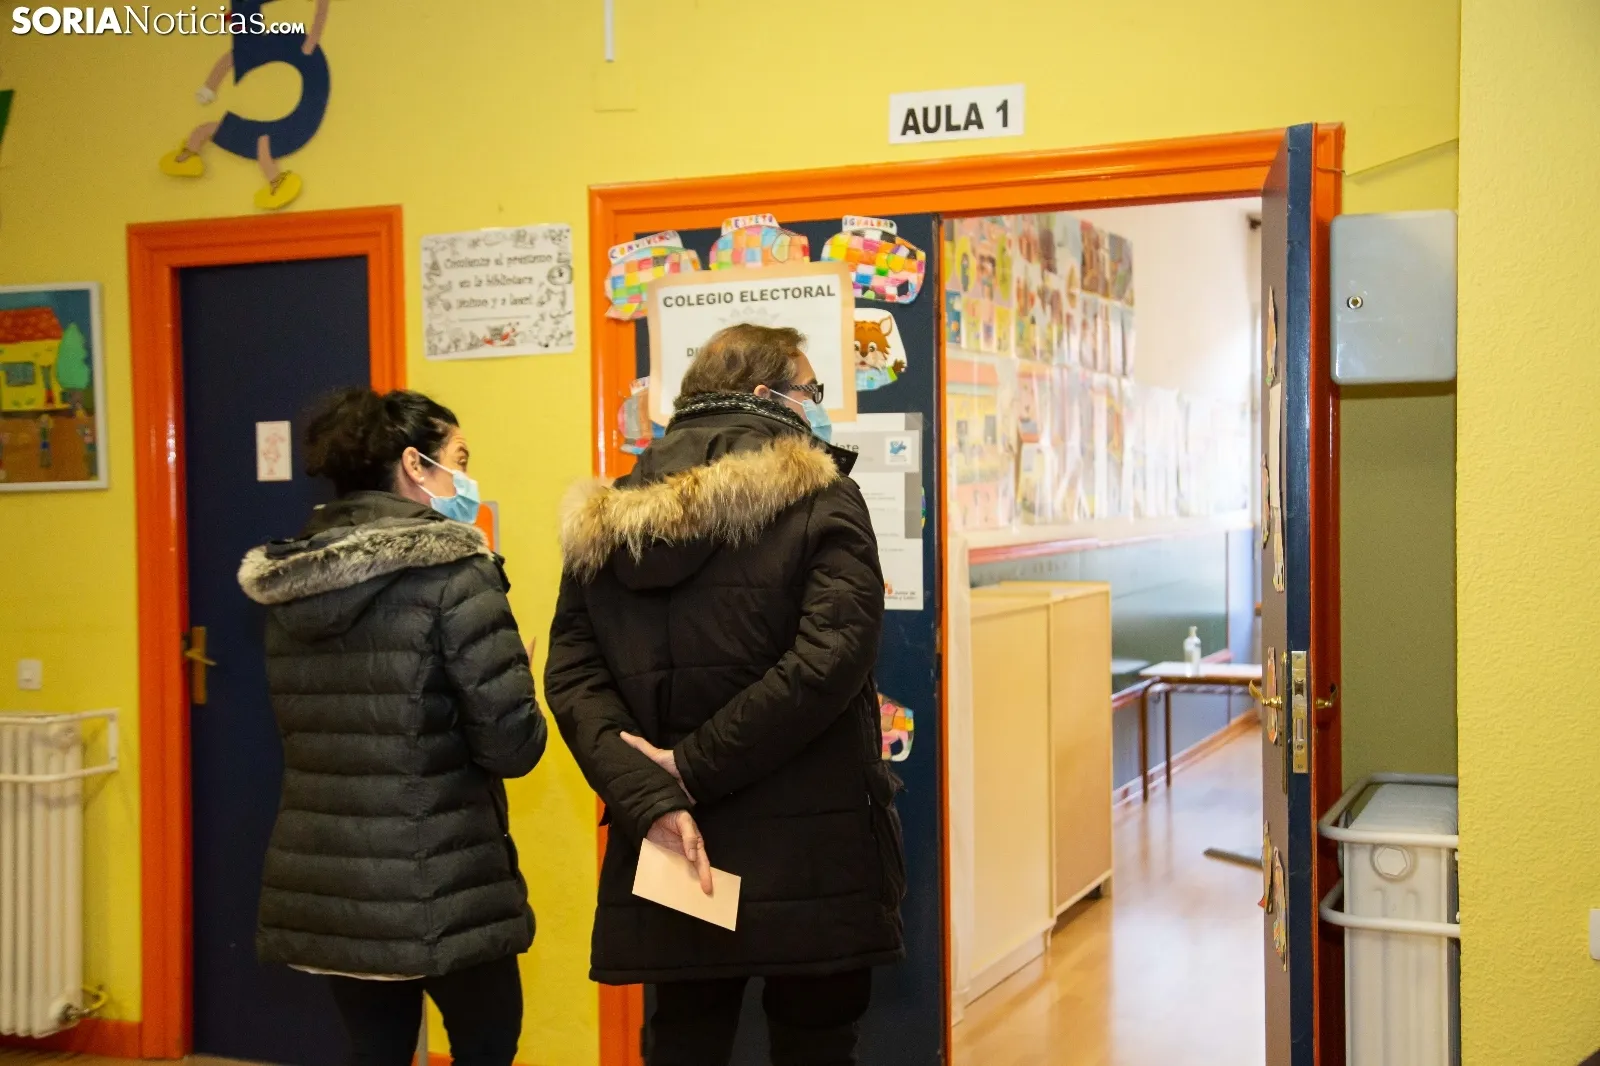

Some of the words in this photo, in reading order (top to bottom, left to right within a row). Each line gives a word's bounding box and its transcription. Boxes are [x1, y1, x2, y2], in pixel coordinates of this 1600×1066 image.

[900, 102, 984, 136] AULA
[996, 98, 1009, 128] 1
[663, 291, 734, 308] COLEGIO
[740, 284, 836, 303] ELECTORAL
